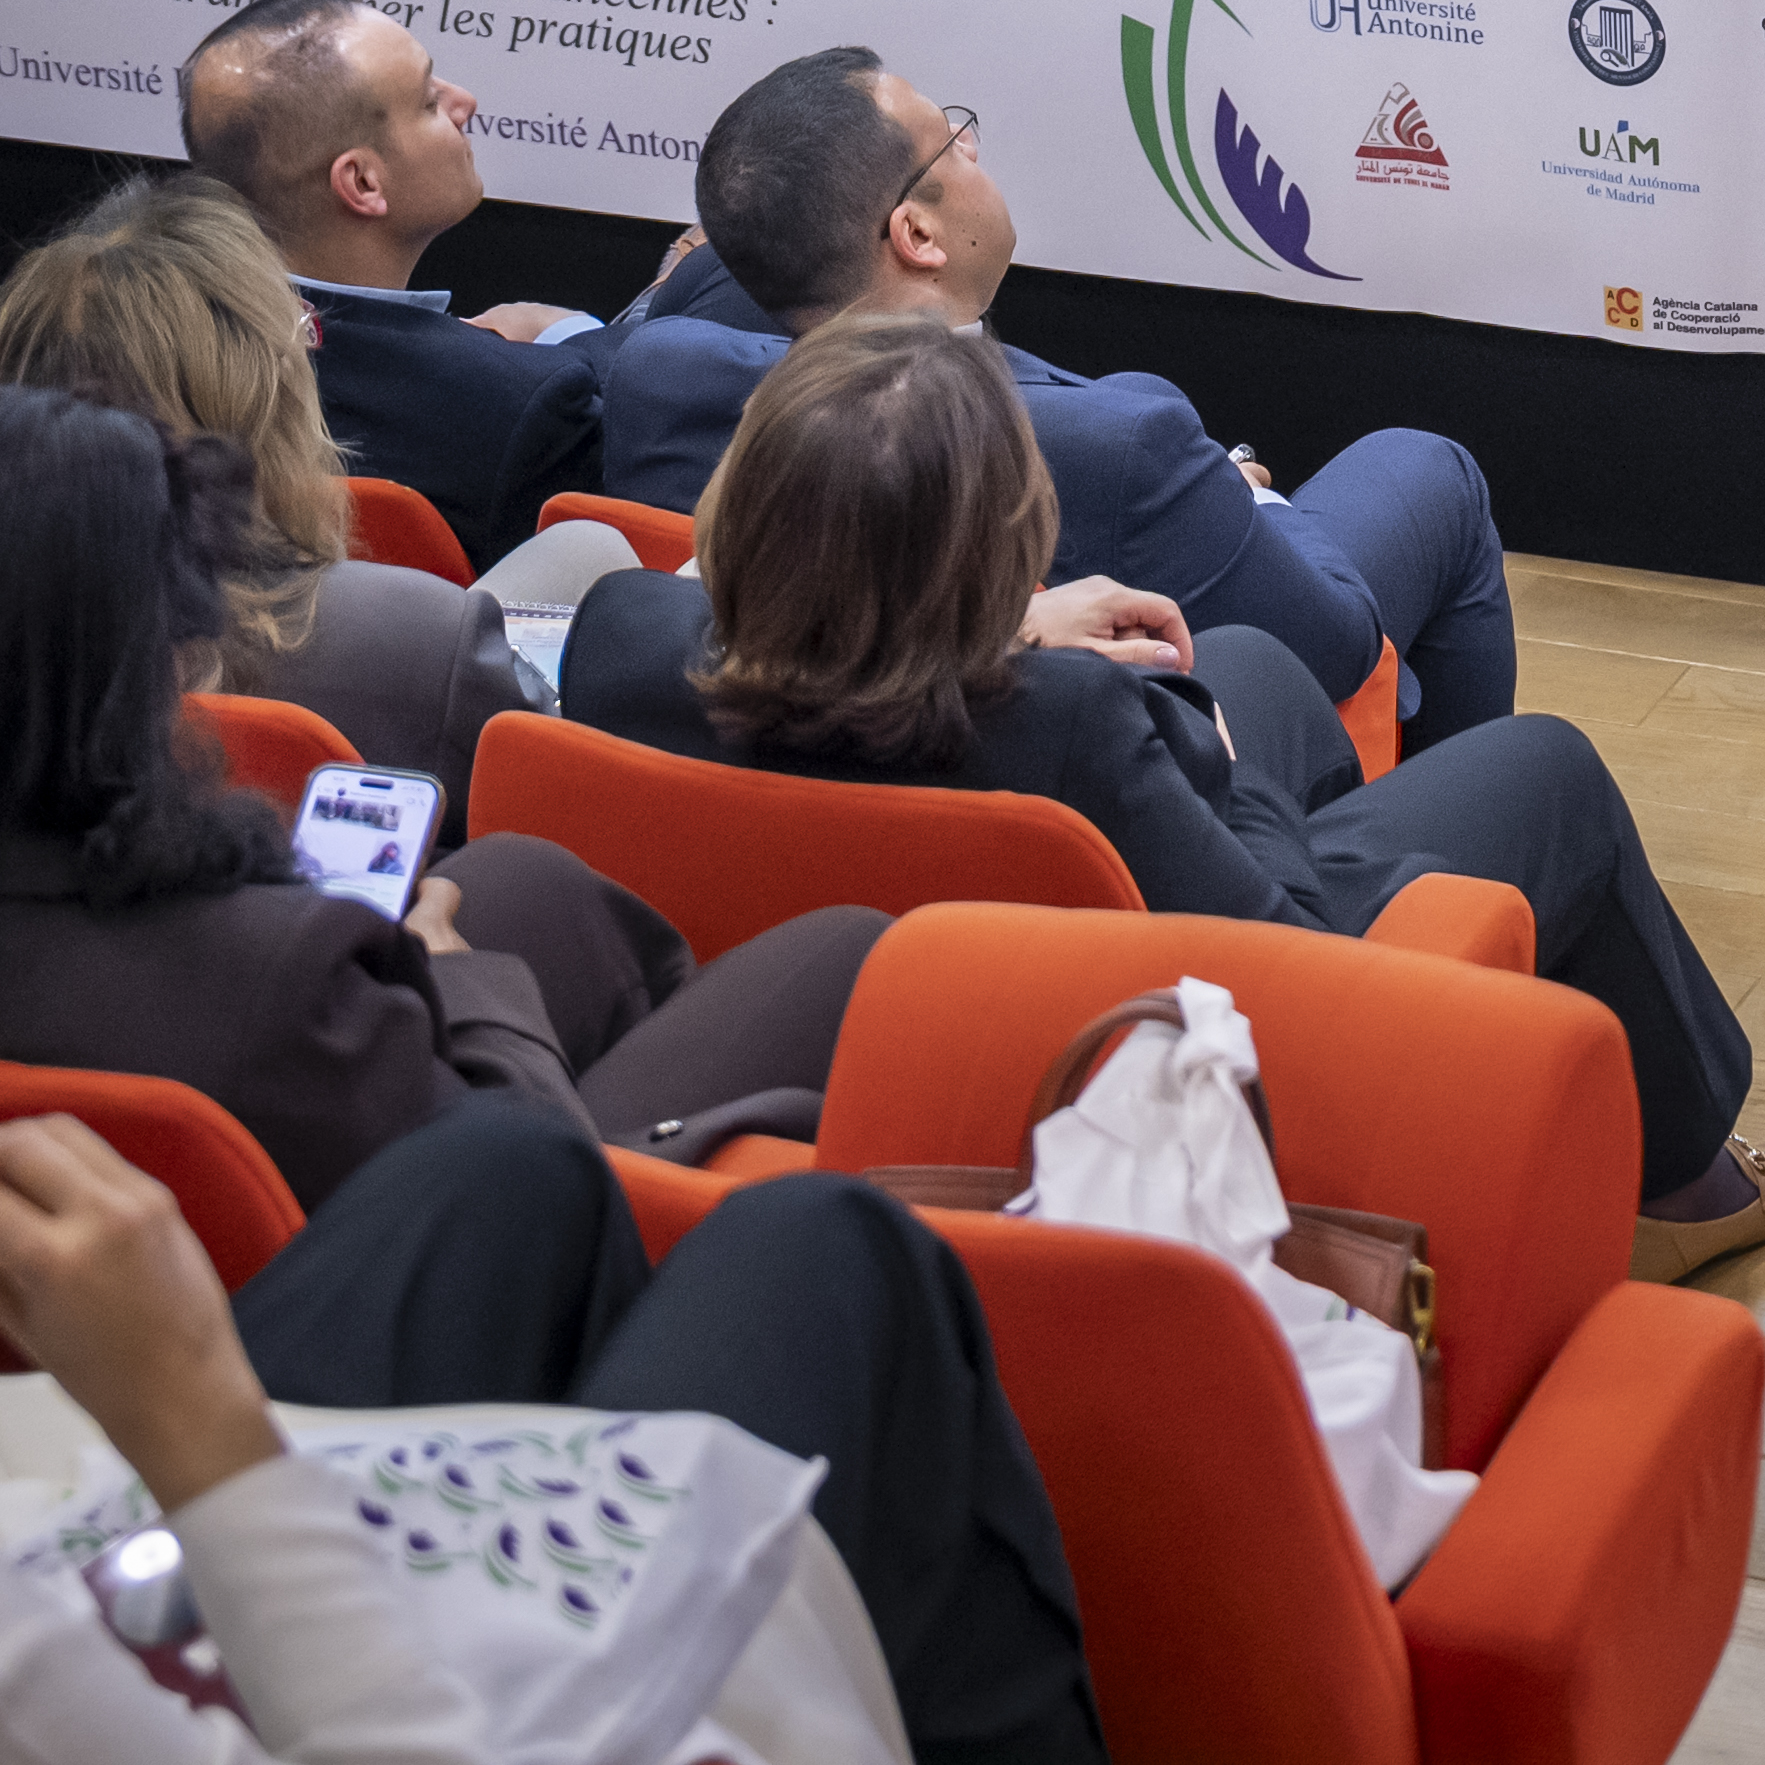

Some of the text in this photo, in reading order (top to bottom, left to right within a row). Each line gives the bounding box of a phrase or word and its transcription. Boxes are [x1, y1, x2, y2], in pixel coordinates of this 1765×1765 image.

[1368, 12, 1484, 44] Antonine
[508, 15, 712, 68] pratiques
[597, 120, 700, 163] Anton
[1542, 161, 1700, 193] Universidad Autónoma
[1587, 185, 1655, 205] de Madrid
[1653, 297, 1758, 312] Agència Catalana
[1653, 308, 1740, 324] de Cooperació
[1653, 320, 1663, 330] al
